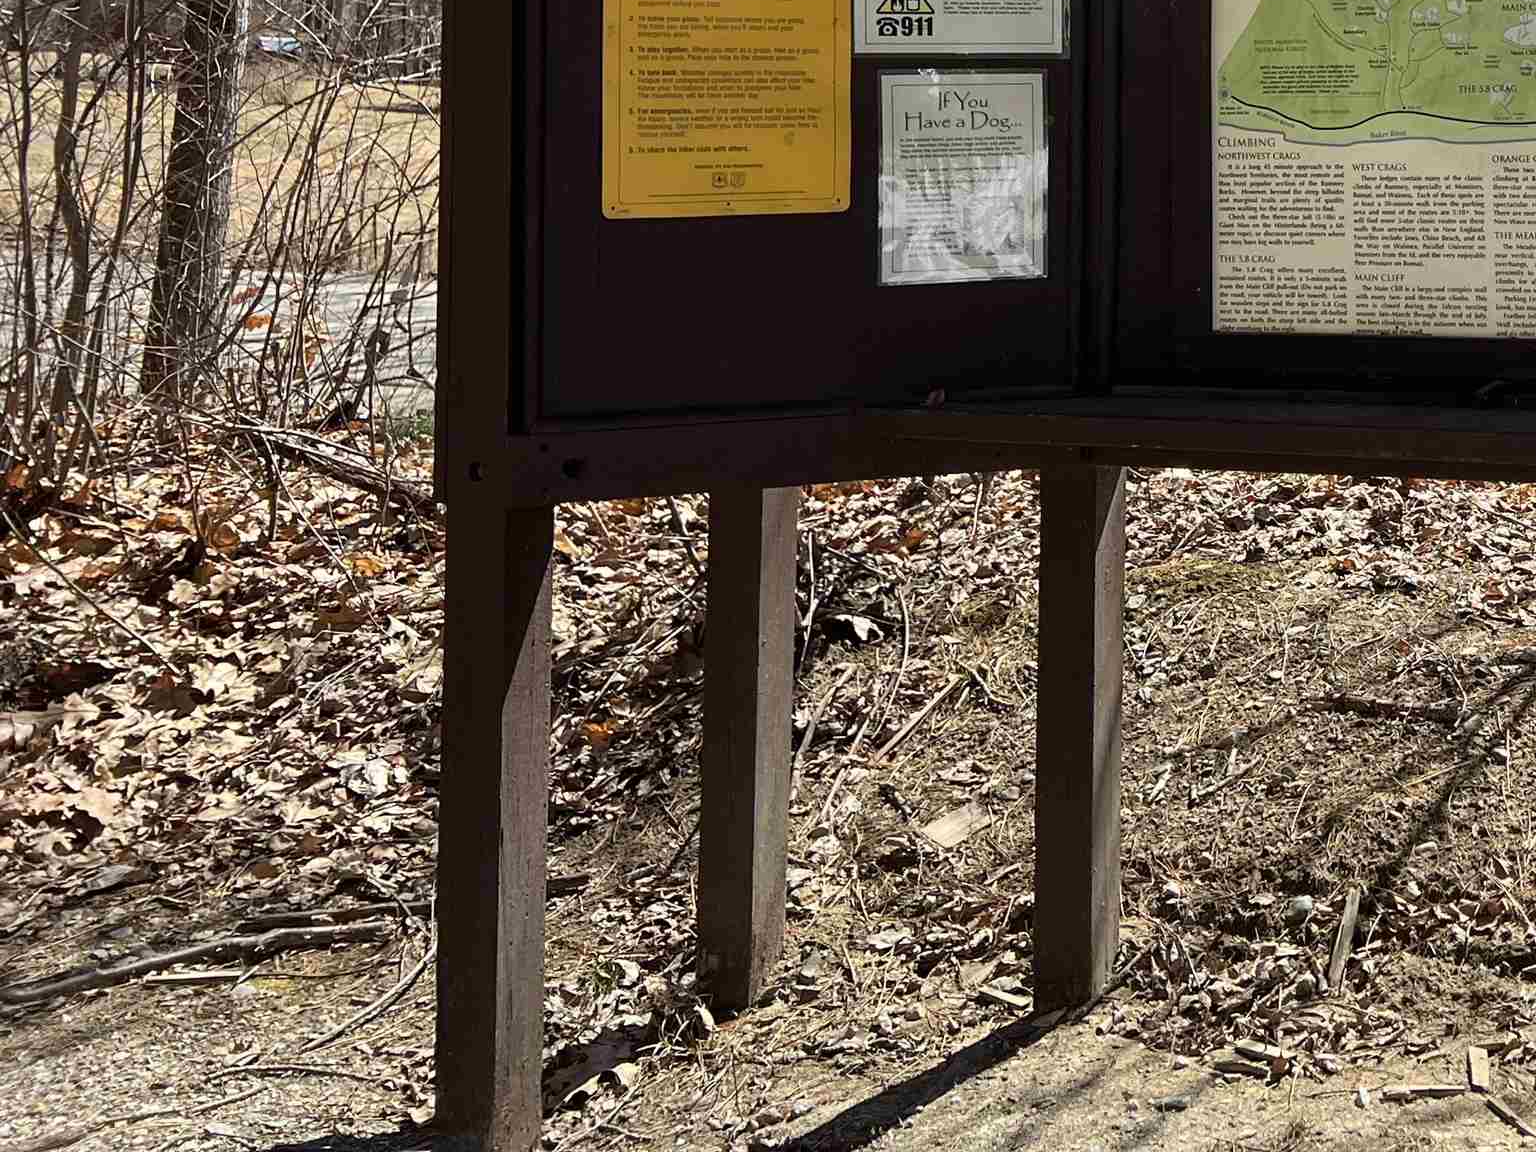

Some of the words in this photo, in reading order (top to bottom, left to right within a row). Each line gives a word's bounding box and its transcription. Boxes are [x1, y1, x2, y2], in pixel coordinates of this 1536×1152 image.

[1501, 3, 1529, 12] MAIN
[901, 16, 934, 37] 911
[1458, 84, 1478, 94] THE
[1492, 84, 1517, 93] CRAG
[953, 90, 989, 111] You
[904, 111, 951, 131] Have
[955, 119, 966, 129] a
[1217, 136, 1276, 148] CLIMBING
[1217, 152, 1271, 161] NORTHWEST
[1272, 151, 1302, 161] CRAGS
[1491, 154, 1530, 163] ORANGE
[1352, 162, 1375, 172] WEST
[1377, 162, 1408, 172] CRAGS
[1494, 232, 1514, 241] THE
[1219, 254, 1235, 264] THE
[1251, 254, 1276, 264] CRAG
[1354, 273, 1379, 282] MAIN
[1380, 273, 1406, 282] CLIFF
